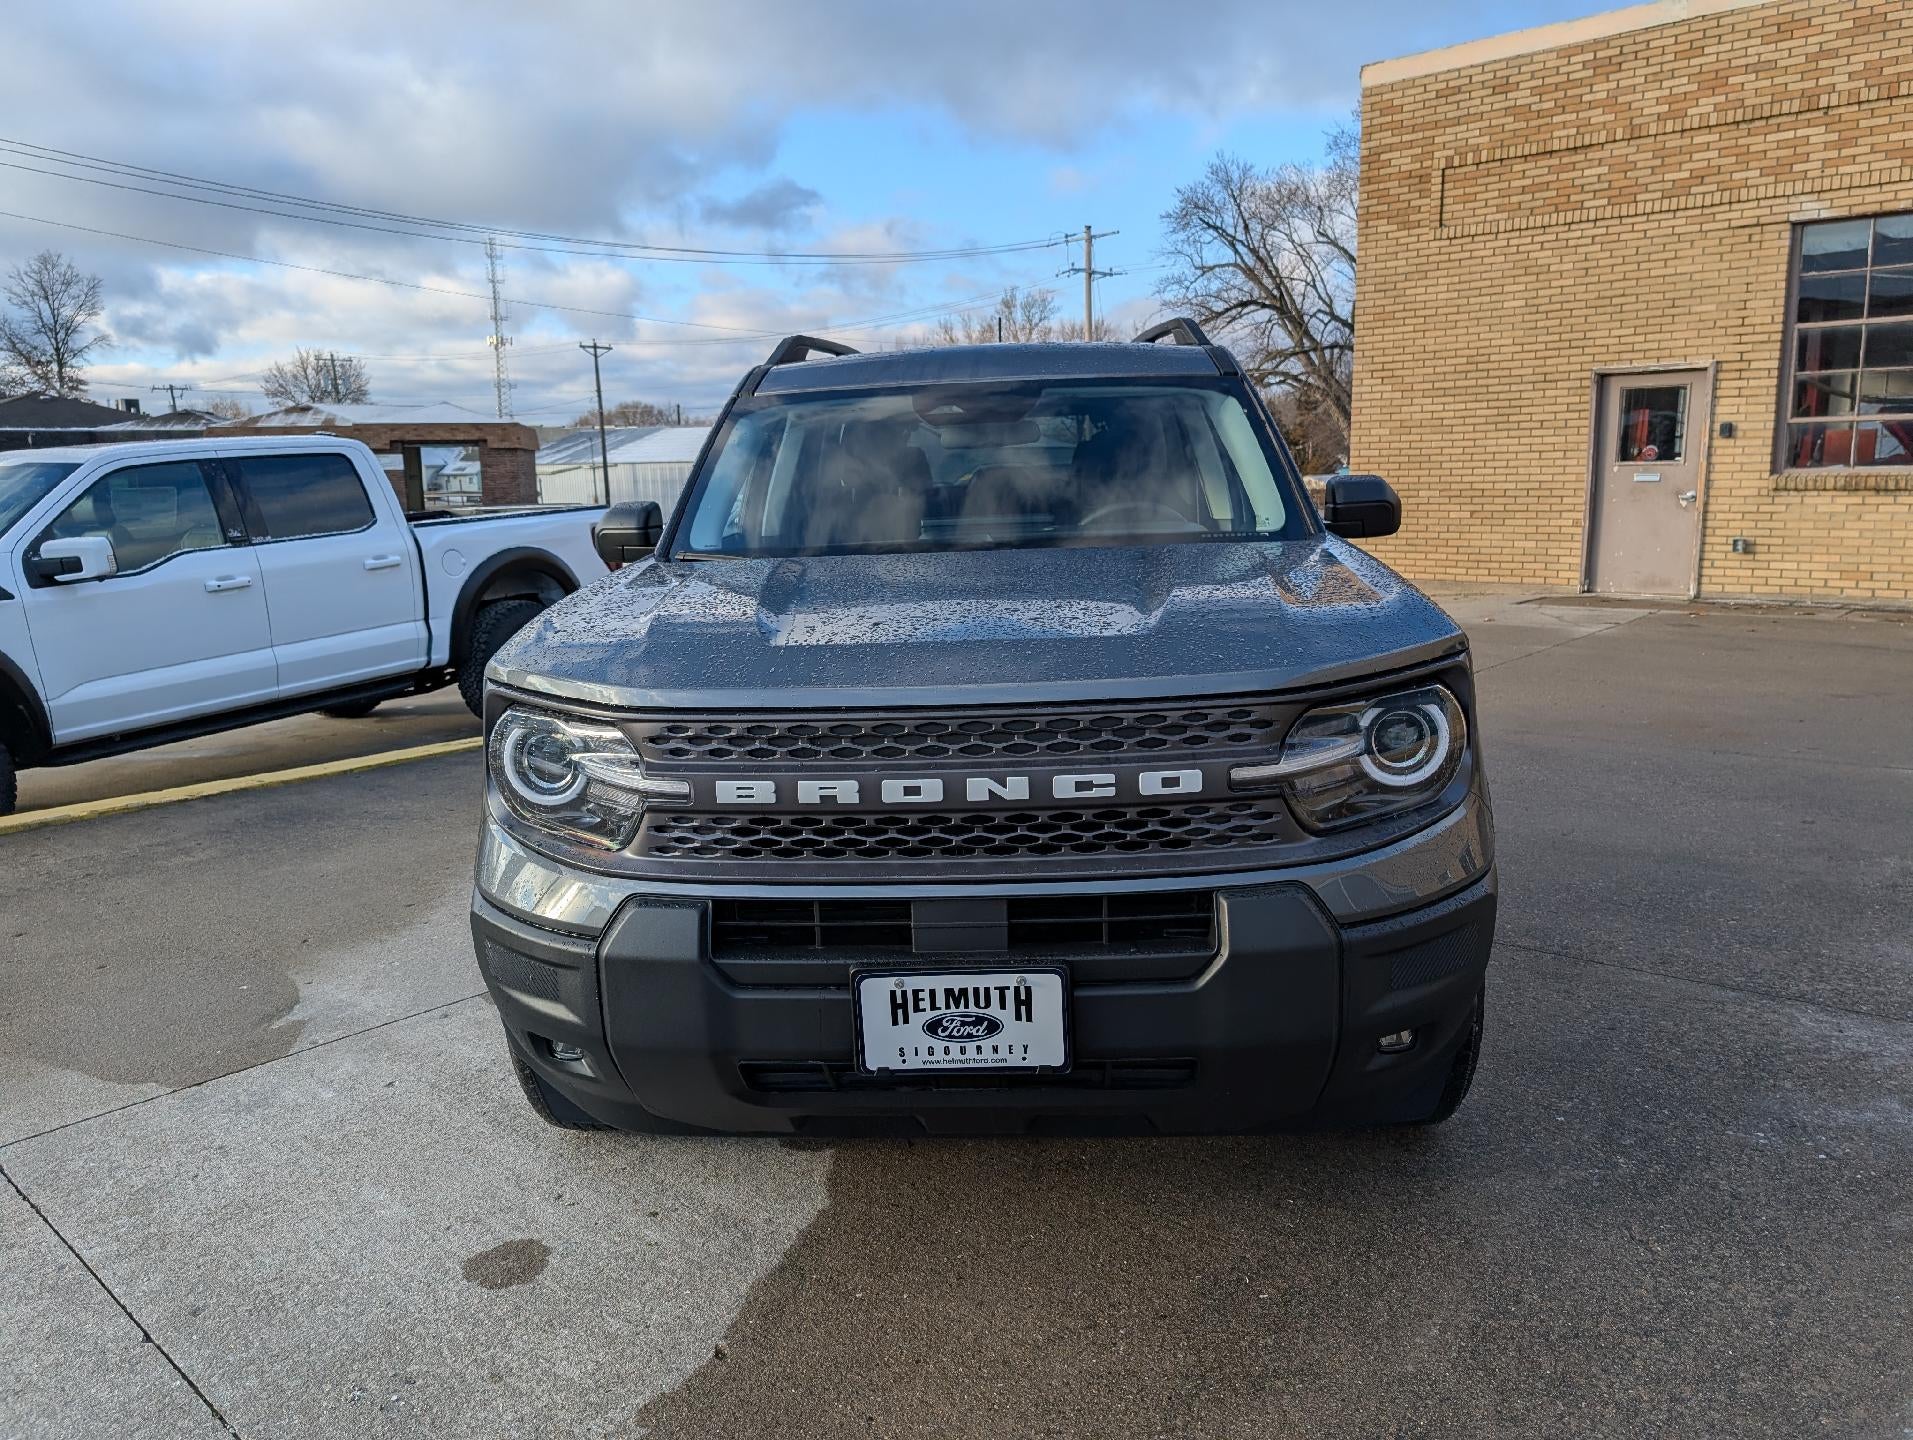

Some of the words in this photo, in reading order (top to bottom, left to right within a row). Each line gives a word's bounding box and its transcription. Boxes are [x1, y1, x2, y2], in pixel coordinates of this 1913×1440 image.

[715, 769, 1203, 804] BRONCO
[889, 985, 1033, 1026] HELMUTH
[937, 1016, 988, 1037] Ford
[898, 1044, 1029, 1057] SIGOURNEY
[921, 1057, 1008, 1066] www.helmuthford.com
